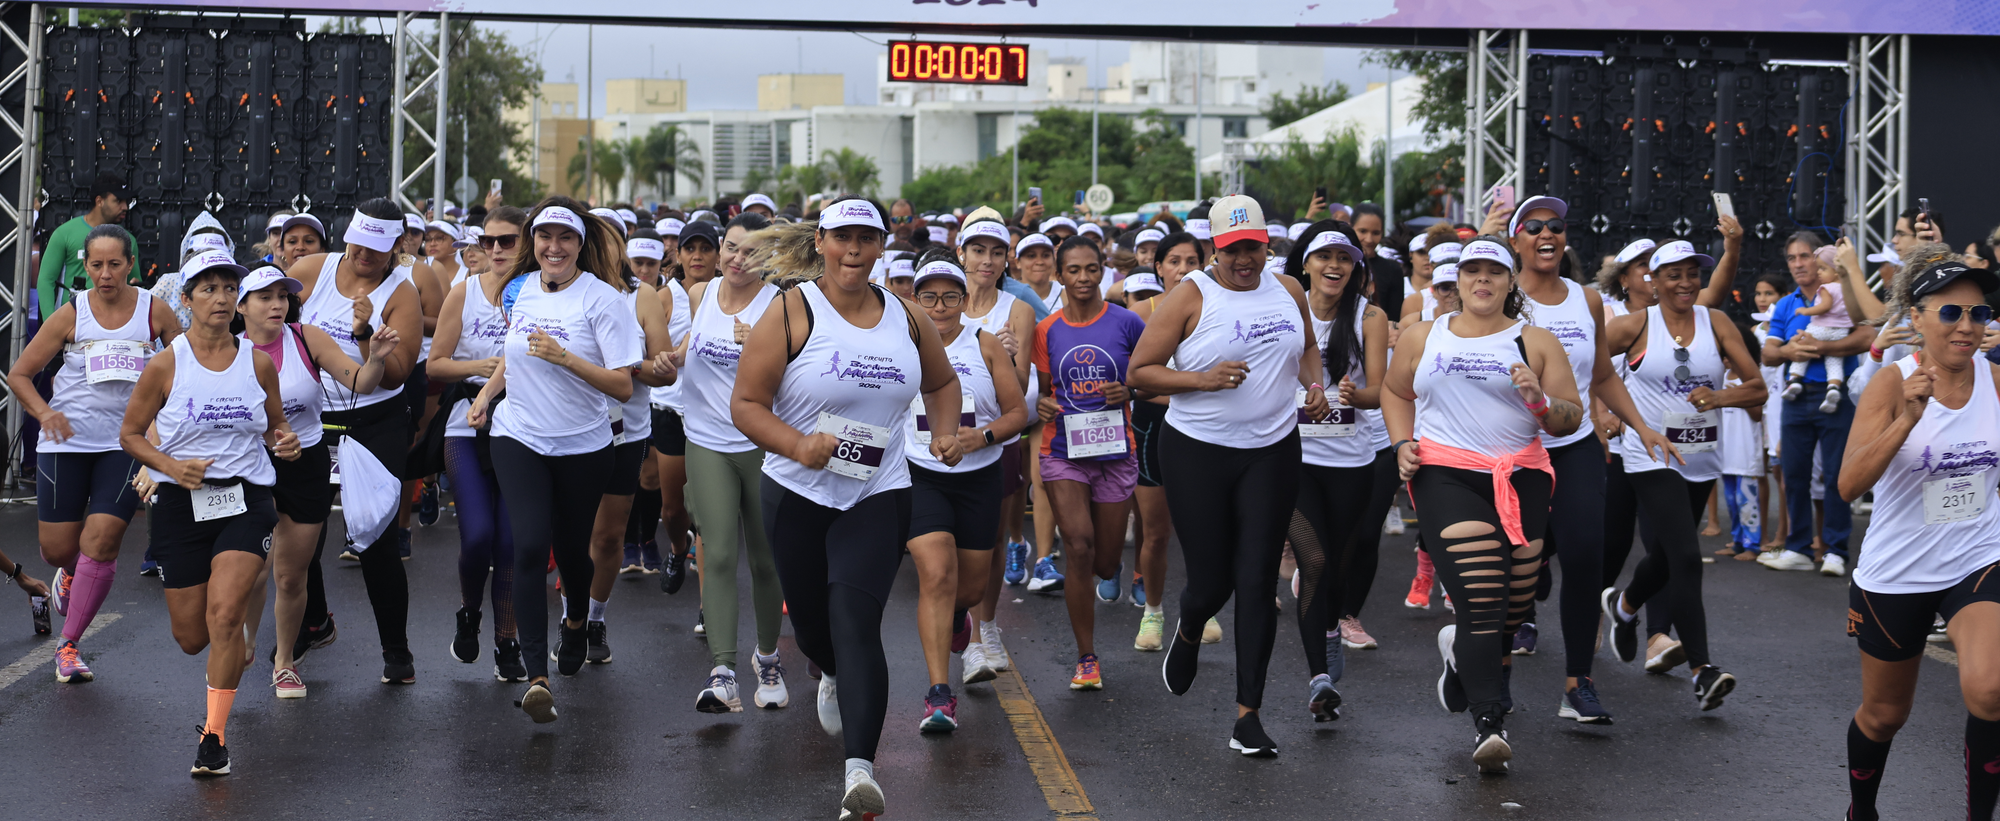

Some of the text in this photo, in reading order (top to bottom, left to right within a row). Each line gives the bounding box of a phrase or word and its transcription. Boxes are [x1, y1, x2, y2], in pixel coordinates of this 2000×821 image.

[892, 44, 1025, 80] 00:00:07
[1090, 190, 1108, 202] 60
[99, 354, 136, 370] 1555
[864, 355, 893, 363] CIRCUITO
[840, 367, 906, 384] MULHER
[1068, 365, 1106, 380] CLUBE
[1312, 409, 1342, 424] 23
[1079, 426, 1116, 444] 1649
[1677, 428, 1707, 442] 434
[837, 441, 864, 462] 65
[207, 493, 236, 507] 2318
[1942, 492, 1976, 508] 2317
